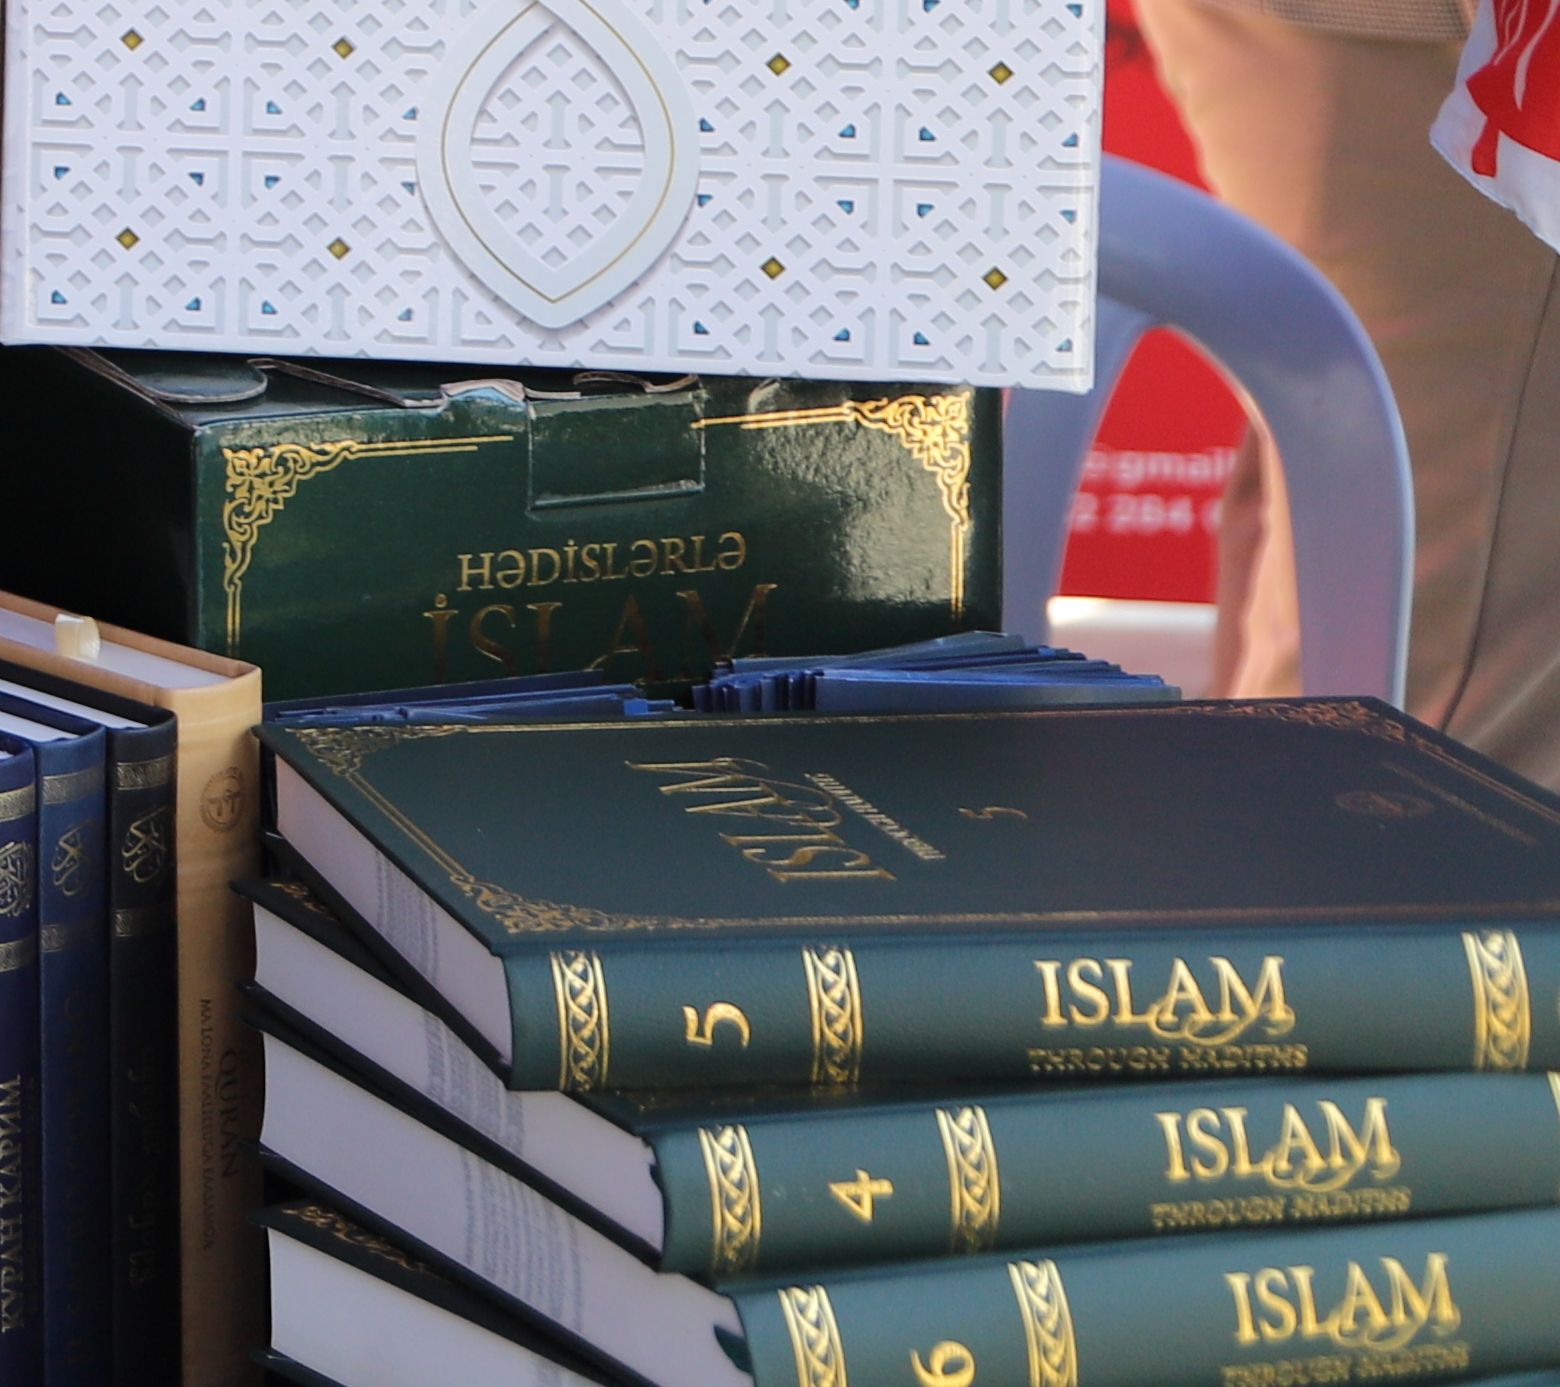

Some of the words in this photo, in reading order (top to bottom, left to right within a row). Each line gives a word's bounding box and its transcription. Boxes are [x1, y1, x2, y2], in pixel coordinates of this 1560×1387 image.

[457, 531, 747, 591] HƏDİSLƏRLƏ
[624, 756, 897, 882] ISLAM
[682, 1001, 752, 1049] 5
[1033, 955, 1296, 1046] ISLAM
[215, 1047, 240, 1178] QURAN
[1155, 1096, 1402, 1193] ISLAM
[828, 1168, 895, 1223] 4
[0, 1216, 23, 1332] КУРАН
[1222, 1251, 1462, 1352] ISLAM
